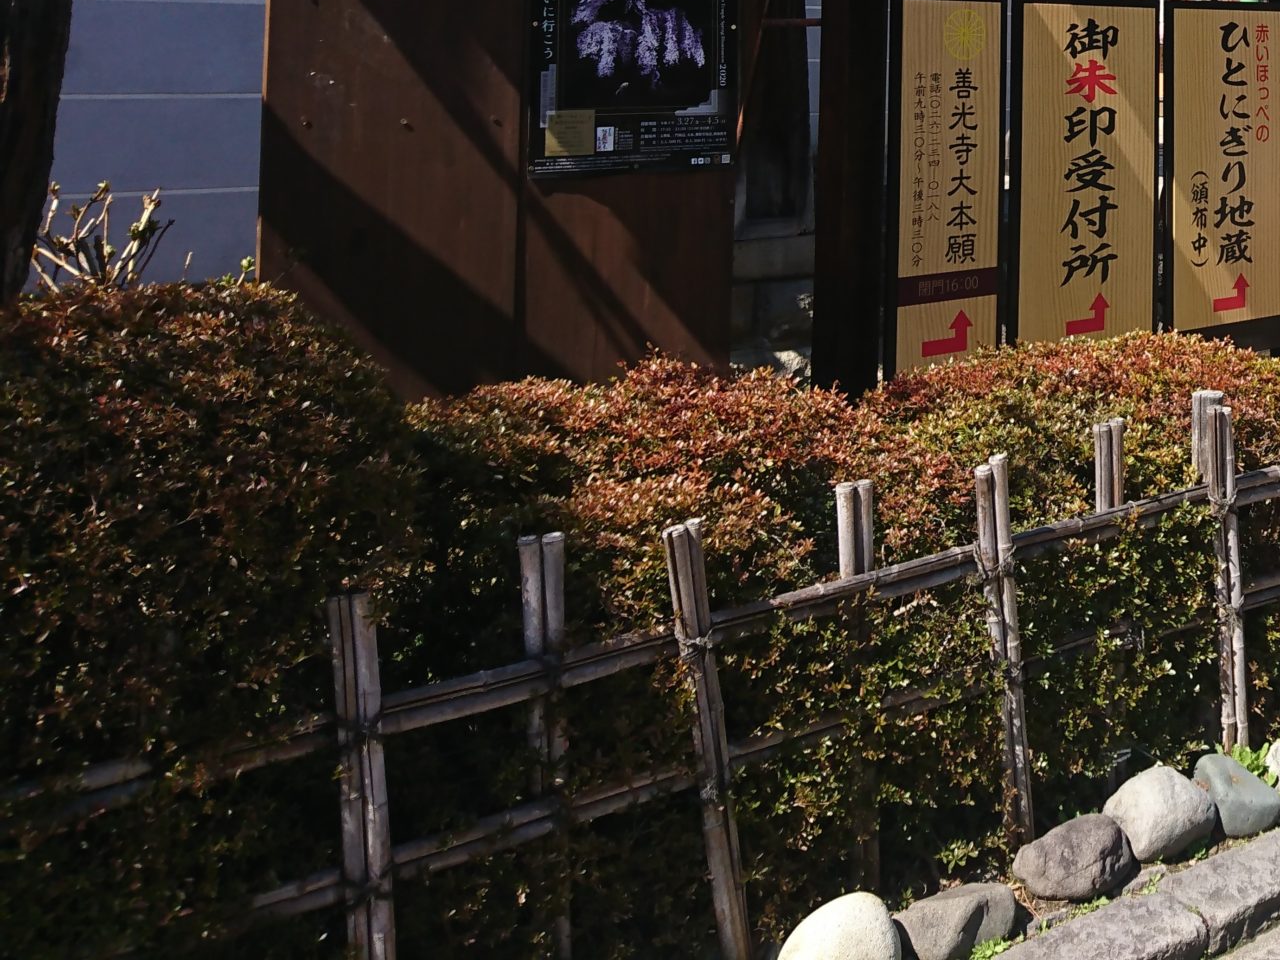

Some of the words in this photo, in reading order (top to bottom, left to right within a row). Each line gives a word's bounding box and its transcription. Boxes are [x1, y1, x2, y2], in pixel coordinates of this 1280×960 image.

[719, 63, 727, 87] 2020
[944, 66, 979, 265] 善光寺大本願
[1059, 17, 1120, 289] 御朱印受付所
[1213, 21, 1256, 266] ひとにぎり地蔵
[1255, 23, 1271, 143] 赤いほっぺの
